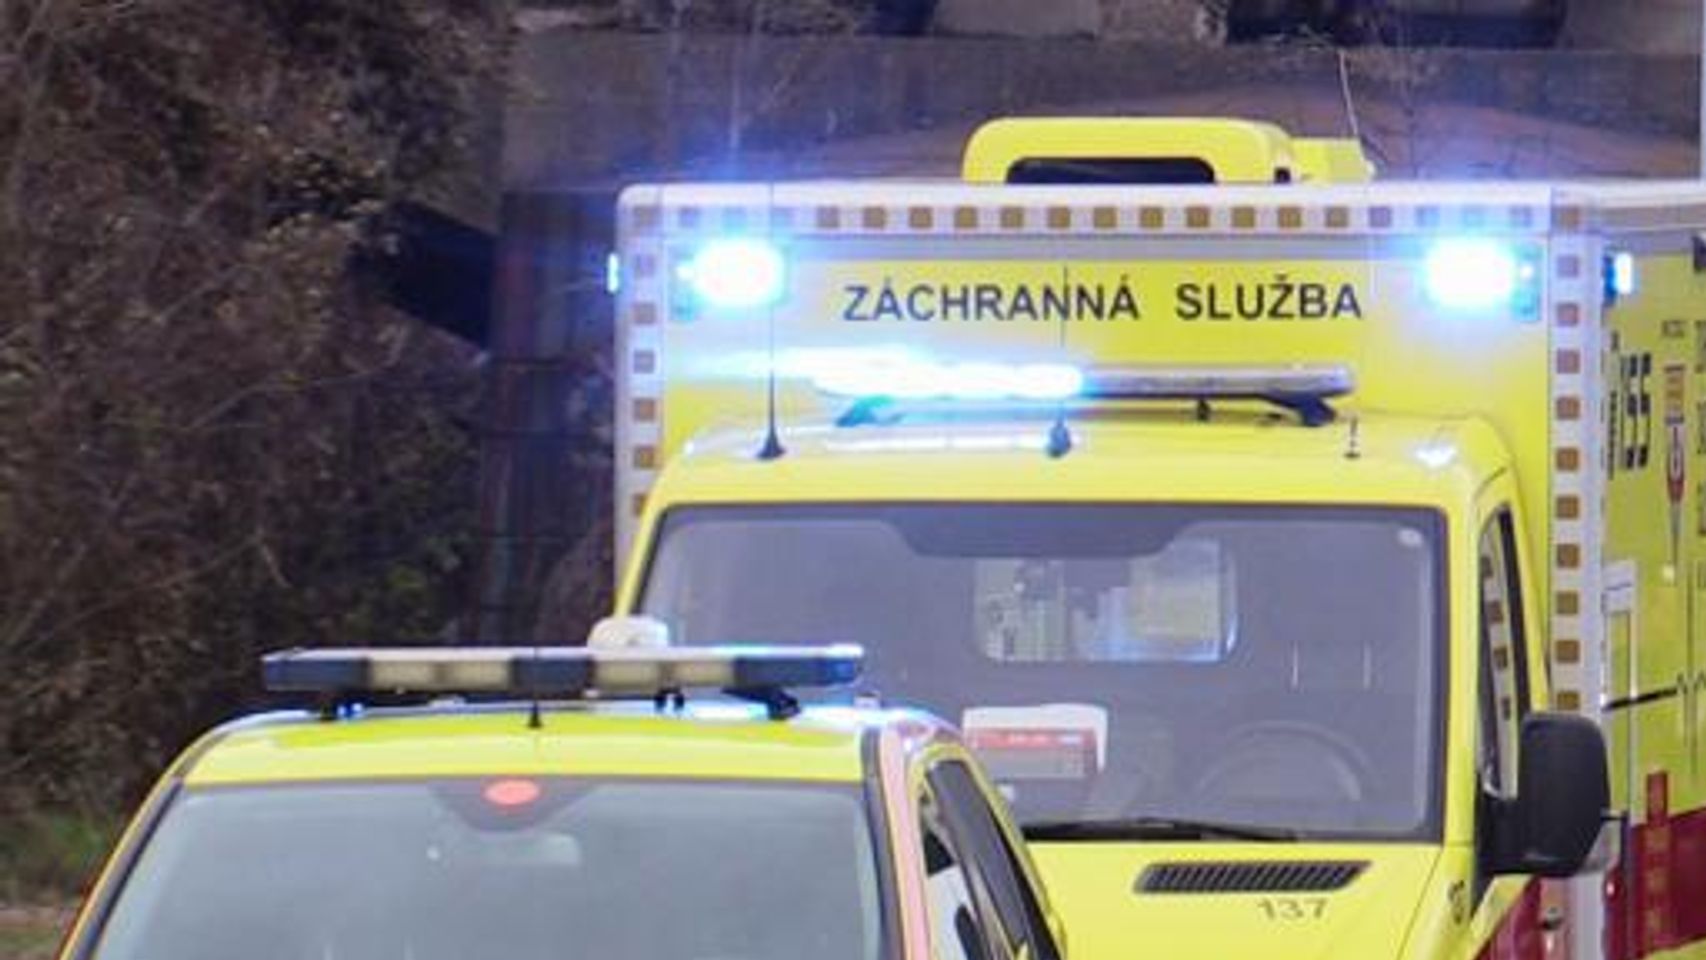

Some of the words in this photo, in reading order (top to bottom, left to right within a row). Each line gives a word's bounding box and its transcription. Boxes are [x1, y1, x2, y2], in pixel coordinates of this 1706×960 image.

[841, 280, 1140, 322] ZÁCHRANNÁ
[1175, 282, 1363, 320] SLUŽBA
[1260, 898, 1329, 921] 137
